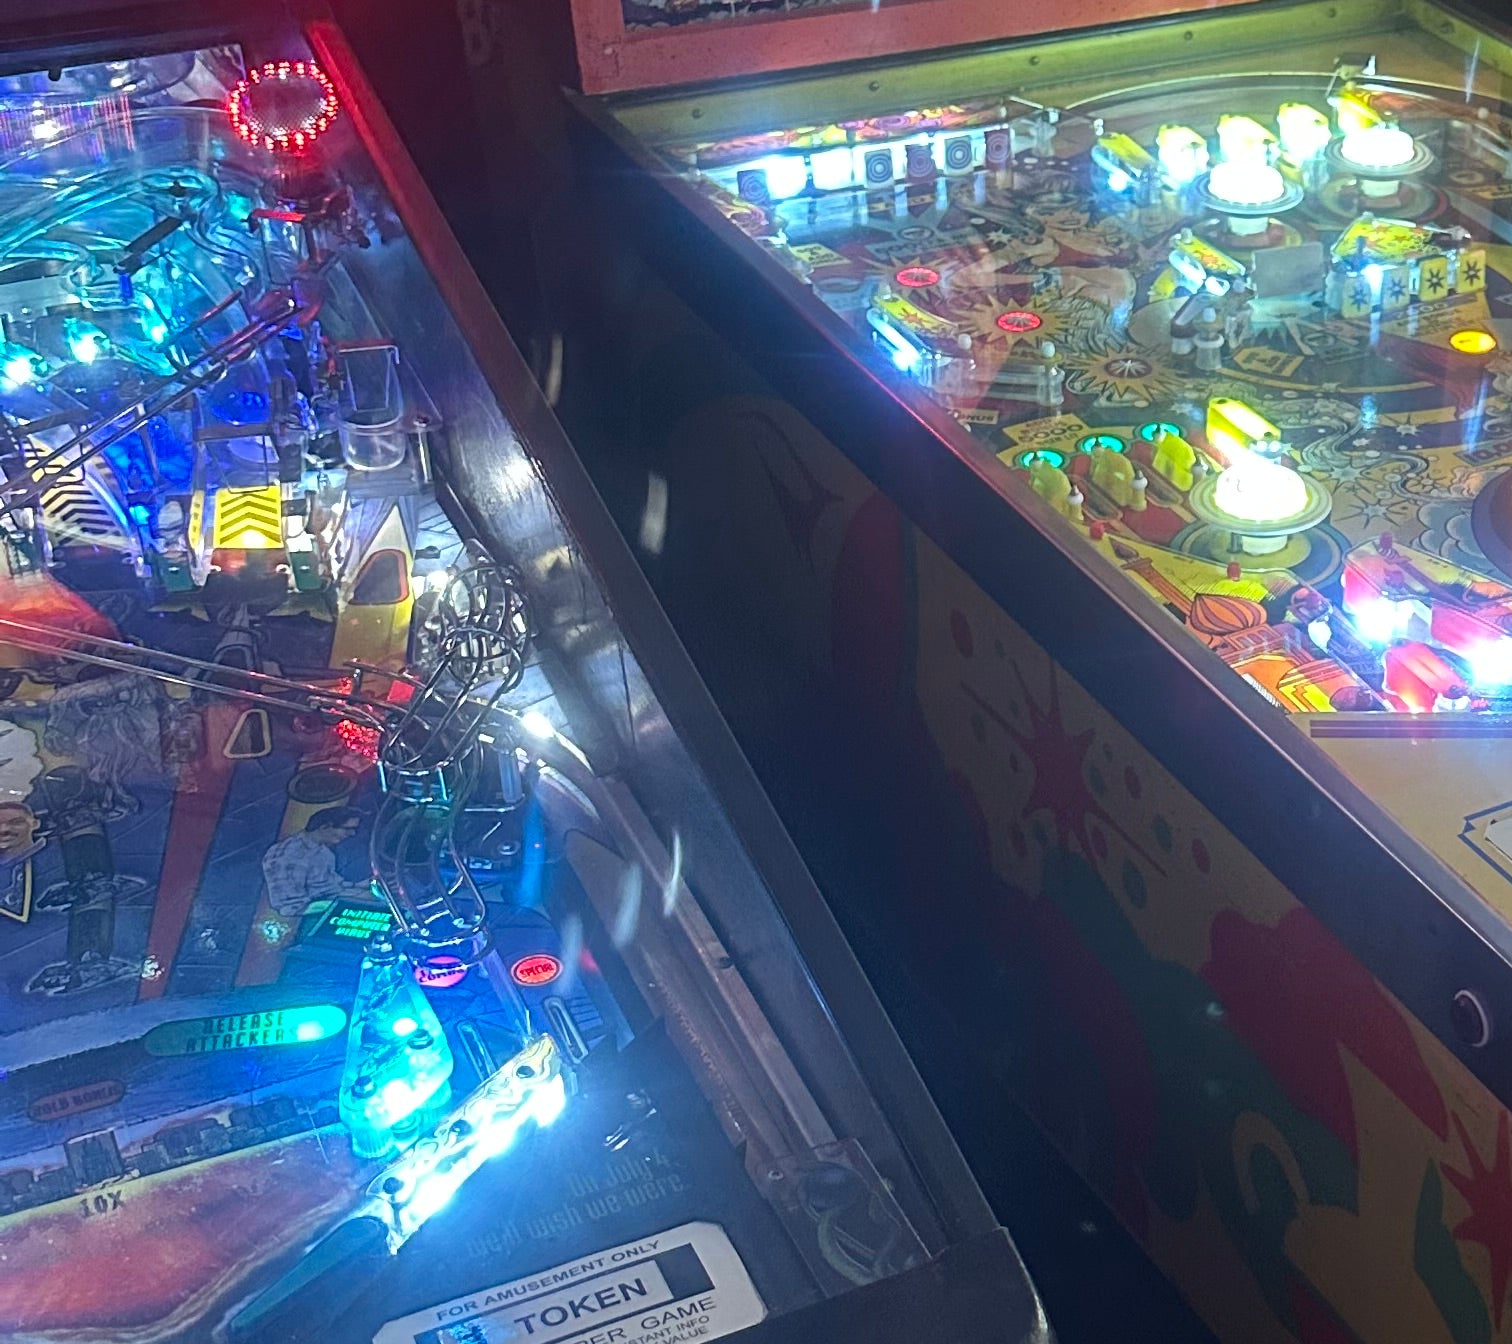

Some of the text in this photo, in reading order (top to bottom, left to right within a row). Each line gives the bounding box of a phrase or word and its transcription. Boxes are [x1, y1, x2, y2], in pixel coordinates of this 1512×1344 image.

[329, 916, 392, 933] COMPUTER
[342, 908, 393, 922] INITIATE
[335, 927, 372, 941] VIRUS
[519, 963, 557, 980] SPECIAL
[203, 1010, 286, 1035] RELEASE
[80, 1189, 125, 1220] 10X
[526, 1201, 585, 1240] wish
[586, 1194, 623, 1221] we
[435, 1239, 663, 1321] FOR AMUSEMENT ONLY
[513, 1277, 648, 1336] TOKEN
[640, 1296, 718, 1330] GAME
[675, 1314, 711, 1333] INFO
